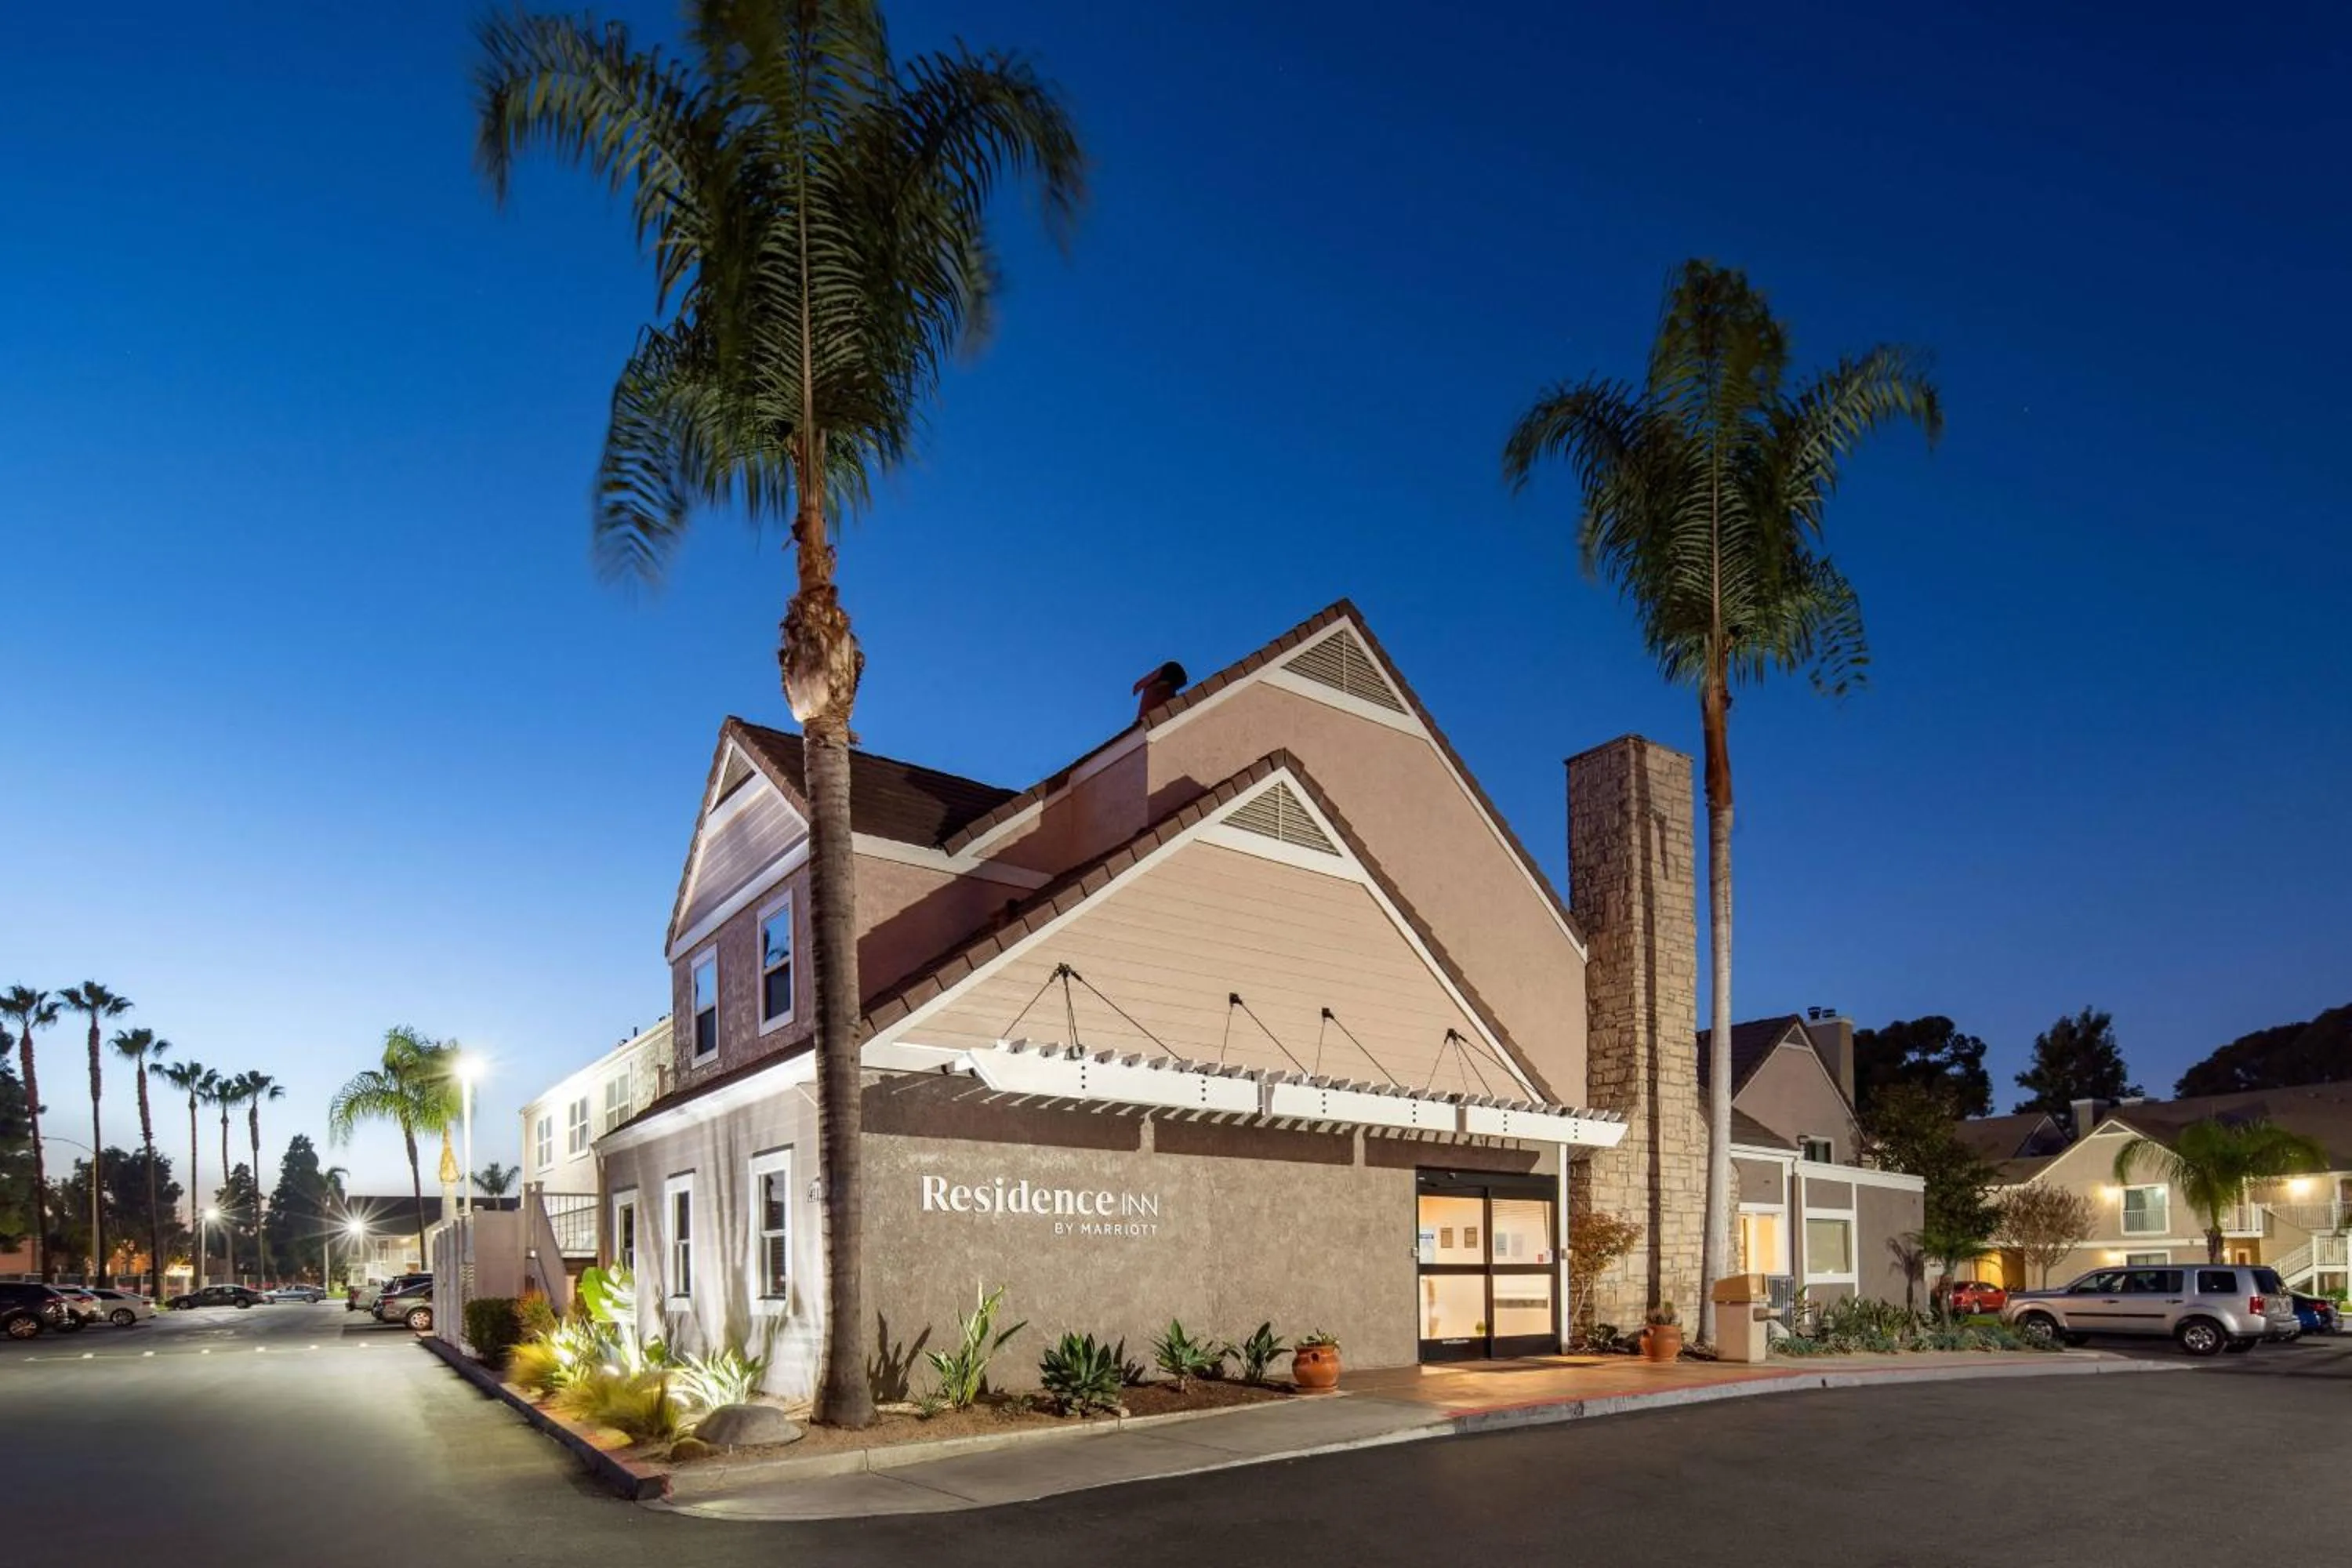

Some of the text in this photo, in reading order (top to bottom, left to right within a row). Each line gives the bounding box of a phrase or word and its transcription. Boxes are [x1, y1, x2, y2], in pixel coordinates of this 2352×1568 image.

[921, 1175, 1158, 1218] Residence INN
[1054, 1223, 1158, 1236] BY MARRIOTT
